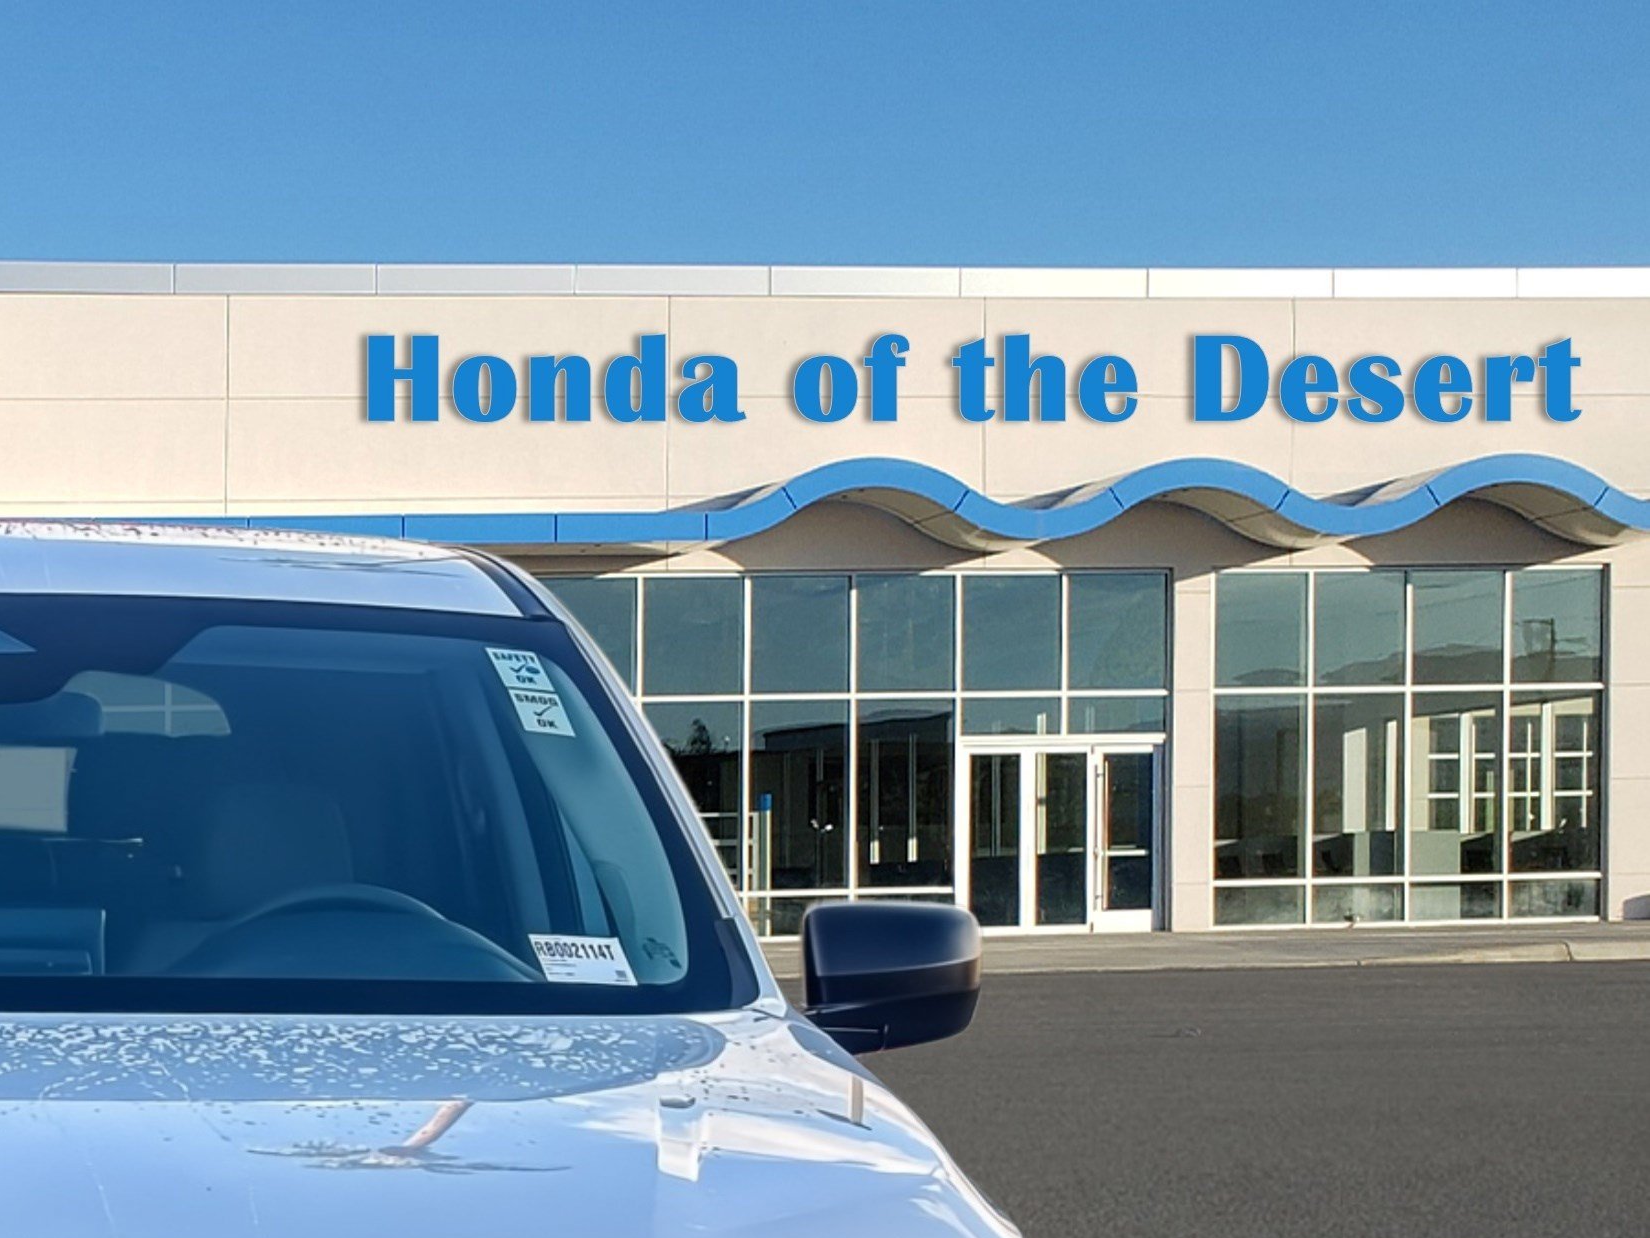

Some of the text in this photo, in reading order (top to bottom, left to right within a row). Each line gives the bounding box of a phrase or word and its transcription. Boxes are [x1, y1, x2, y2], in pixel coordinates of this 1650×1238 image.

[366, 333, 1582, 423] Honda of the Desert
[515, 693, 559, 707] SMOG
